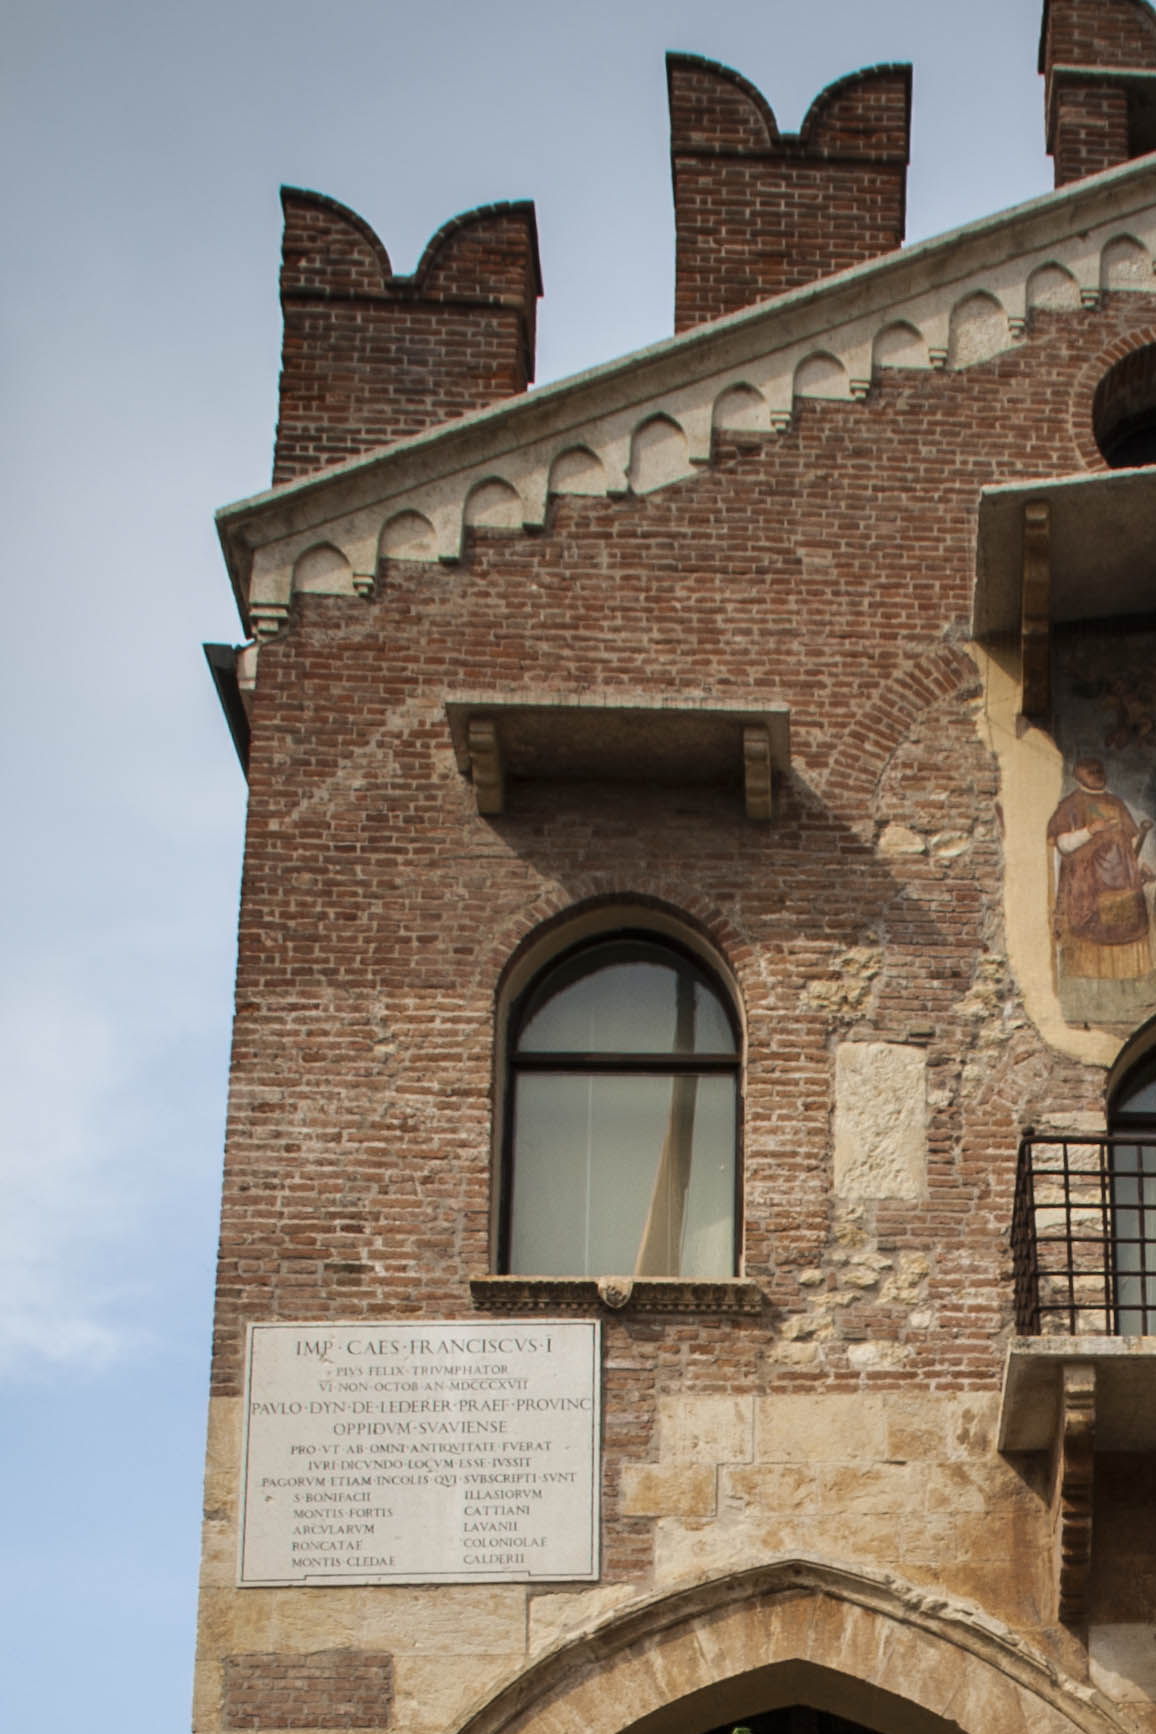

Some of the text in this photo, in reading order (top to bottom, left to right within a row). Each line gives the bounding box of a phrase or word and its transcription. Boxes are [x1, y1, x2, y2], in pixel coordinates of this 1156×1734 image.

[296, 1335, 553, 1356] IMP CAES FRANCISCVS I
[336, 1365, 509, 1377] PIVS FELIX TRIVMPHATOR
[338, 1382, 368, 1392] NON
[374, 1382, 418, 1392] OCTOB
[424, 1381, 443, 1391] AN
[251, 1402, 302, 1415] PAVLO
[309, 1401, 346, 1415] DYN
[352, 1401, 374, 1413] DE
[380, 1400, 451, 1414] LEDERER
[516, 1398, 591, 1411] PROVINC
[333, 1420, 509, 1435] OPPIDVM SVAVIENSE
[290, 1445, 316, 1455] PRO
[321, 1445, 339, 1455] VT
[346, 1444, 364, 1455] AB
[369, 1443, 405, 1454] OMNI
[502, 1441, 552, 1451] FVERAT
[308, 1460, 335, 1471] IVRI
[340, 1459, 403, 1470] DICVNDO
[458, 1458, 487, 1469] ESSE
[492, 1457, 532, 1468] IVSSIT
[262, 1472, 577, 1488] PAGORVM ETIAM INCOLIS QVI SVBSCRIPTI SVNT
[464, 1489, 543, 1500] ILLASIORVM
[293, 1507, 393, 1519] MONTIS FORTIS
[464, 1505, 531, 1516] CATTIANI
[293, 1524, 375, 1535] ARCVLARVM
[463, 1522, 517, 1533] LAVANII
[291, 1557, 341, 1569] MONTIS
[463, 1553, 525, 1565] CALDERII
